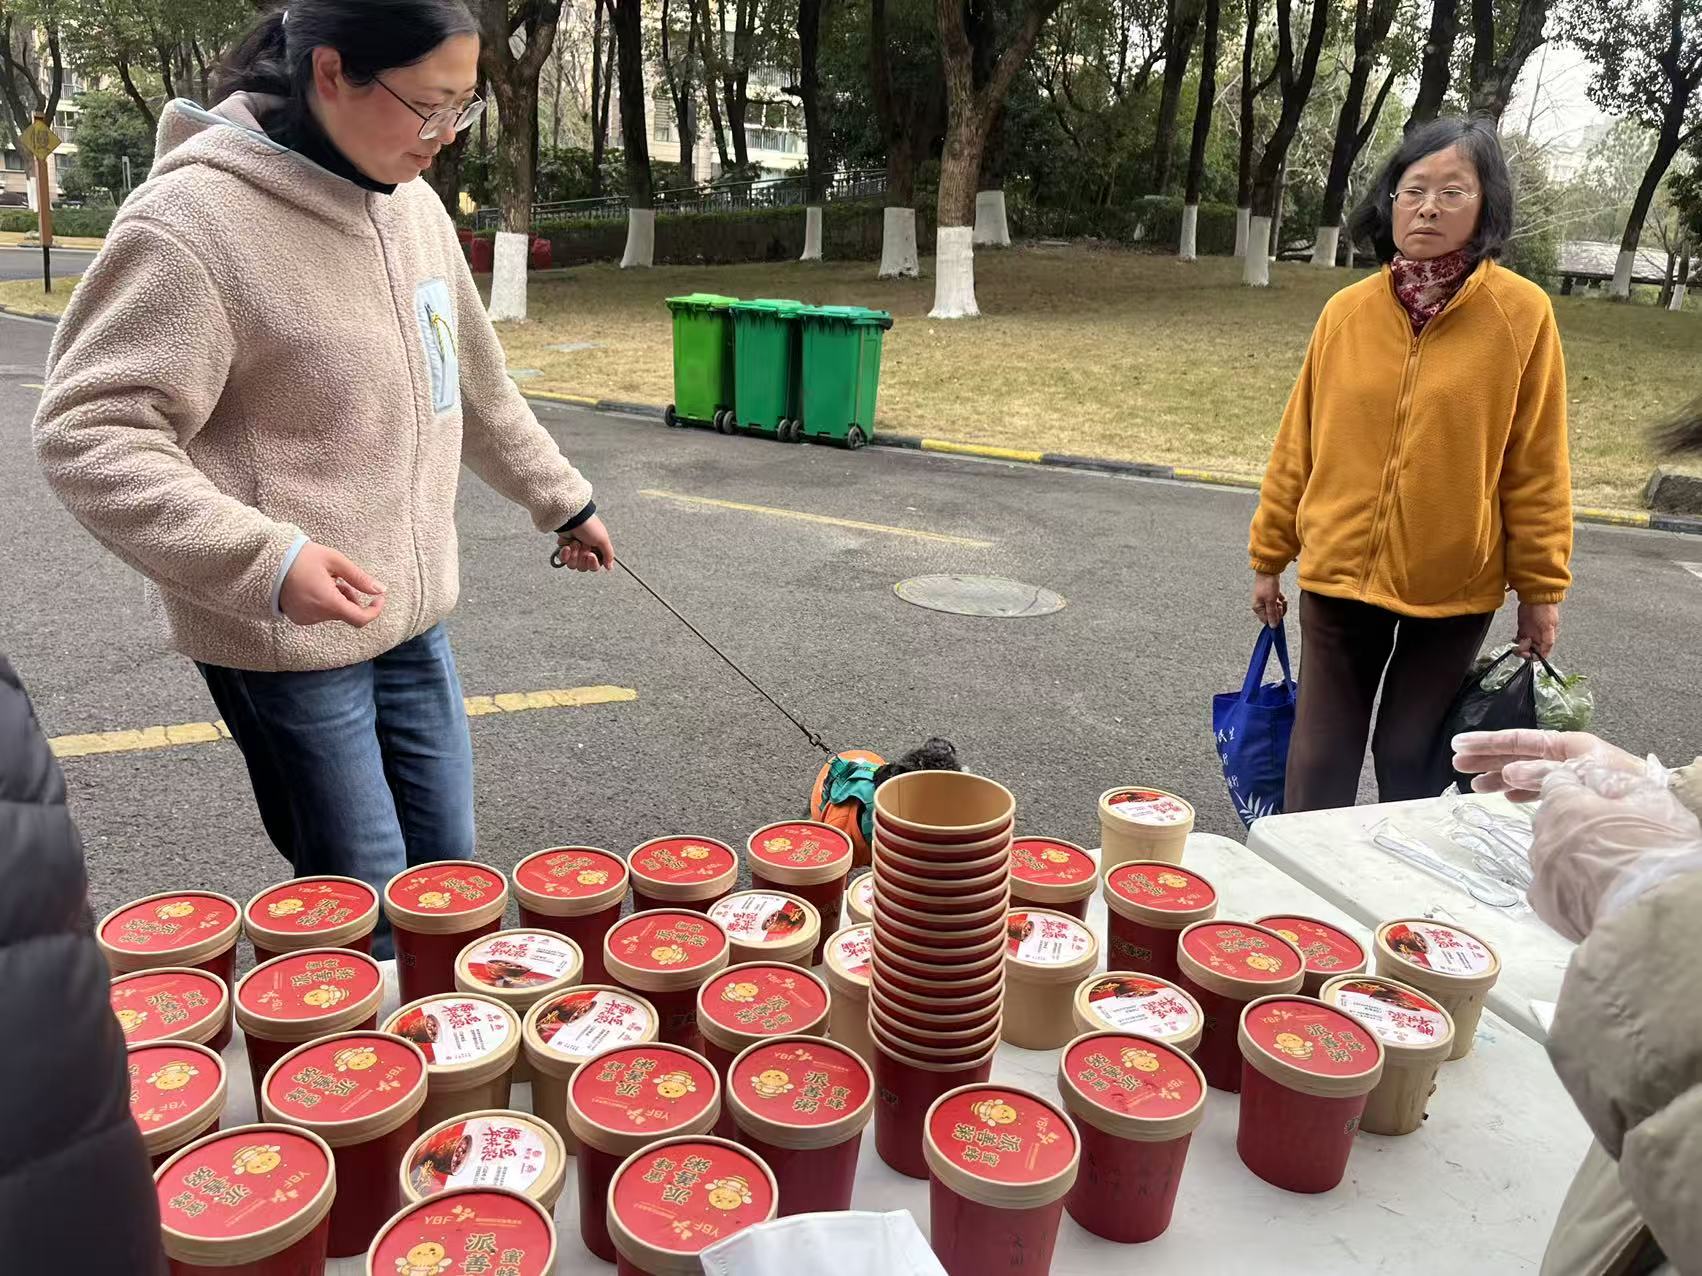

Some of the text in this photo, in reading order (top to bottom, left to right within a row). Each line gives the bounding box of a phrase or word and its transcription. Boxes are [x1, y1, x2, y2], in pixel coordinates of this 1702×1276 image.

[1262, 1015, 1280, 1025] YBF
[774, 1050, 794, 1061] YBF
[1304, 1024, 1354, 1063] 派善粥
[292, 1067, 359, 1096] 派善粥
[385, 1066, 406, 1080] YBF
[614, 1057, 658, 1097] 派善粥
[1083, 1052, 1142, 1091] 派善粥
[1165, 1078, 1185, 1090] YBF
[792, 1070, 831, 1115] 派善粥
[824, 1085, 851, 1111] 蜜蜂
[159, 1100, 188, 1112] YBF
[644, 1107, 671, 1121] YBF
[1034, 1116, 1049, 1133] YBF
[952, 1123, 1022, 1153] 派善粥
[961, 1145, 1000, 1167] 蜜蜂
[283, 1171, 311, 1190] YBF
[644, 1156, 676, 1184] 蜜蜂
[661, 1154, 713, 1205] 派善粥
[183, 1166, 252, 1207] 派善粥
[168, 1191, 208, 1217] 蜜蜂
[424, 1215, 454, 1225] YBF
[693, 1218, 720, 1237] YBF
[459, 1232, 498, 1276] 派善
